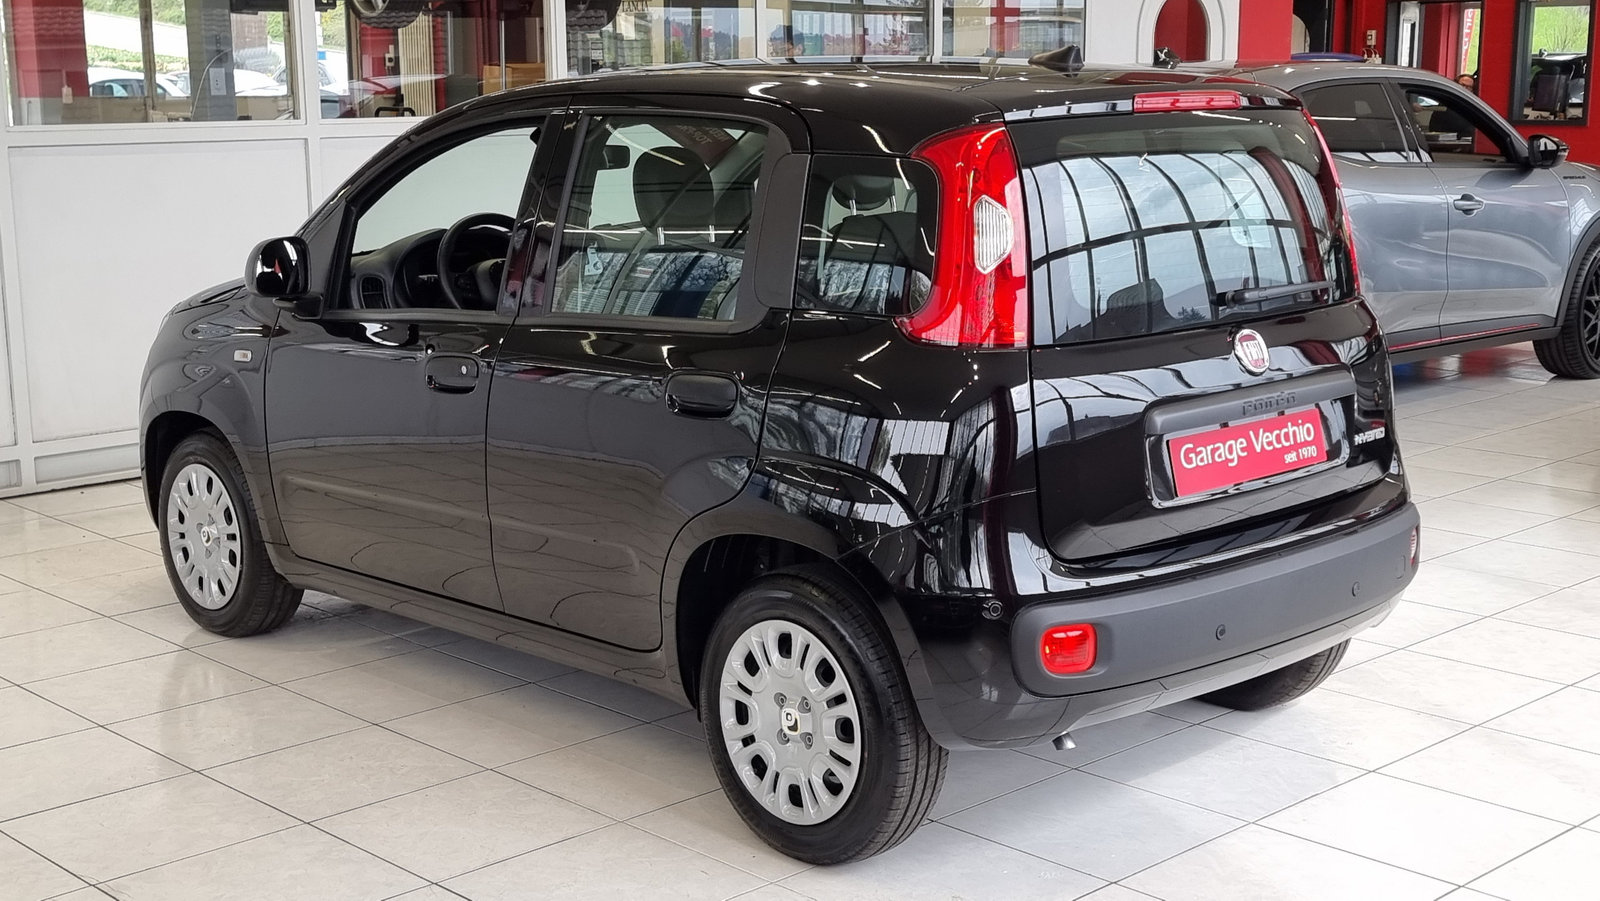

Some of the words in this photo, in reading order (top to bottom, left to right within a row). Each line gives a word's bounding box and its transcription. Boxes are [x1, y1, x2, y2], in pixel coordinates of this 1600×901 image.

[1180, 437, 1248, 469] Garage
[1249, 419, 1315, 453] Vecchio
[1284, 450, 1297, 464] seit
[1299, 445, 1318, 460] 1970
